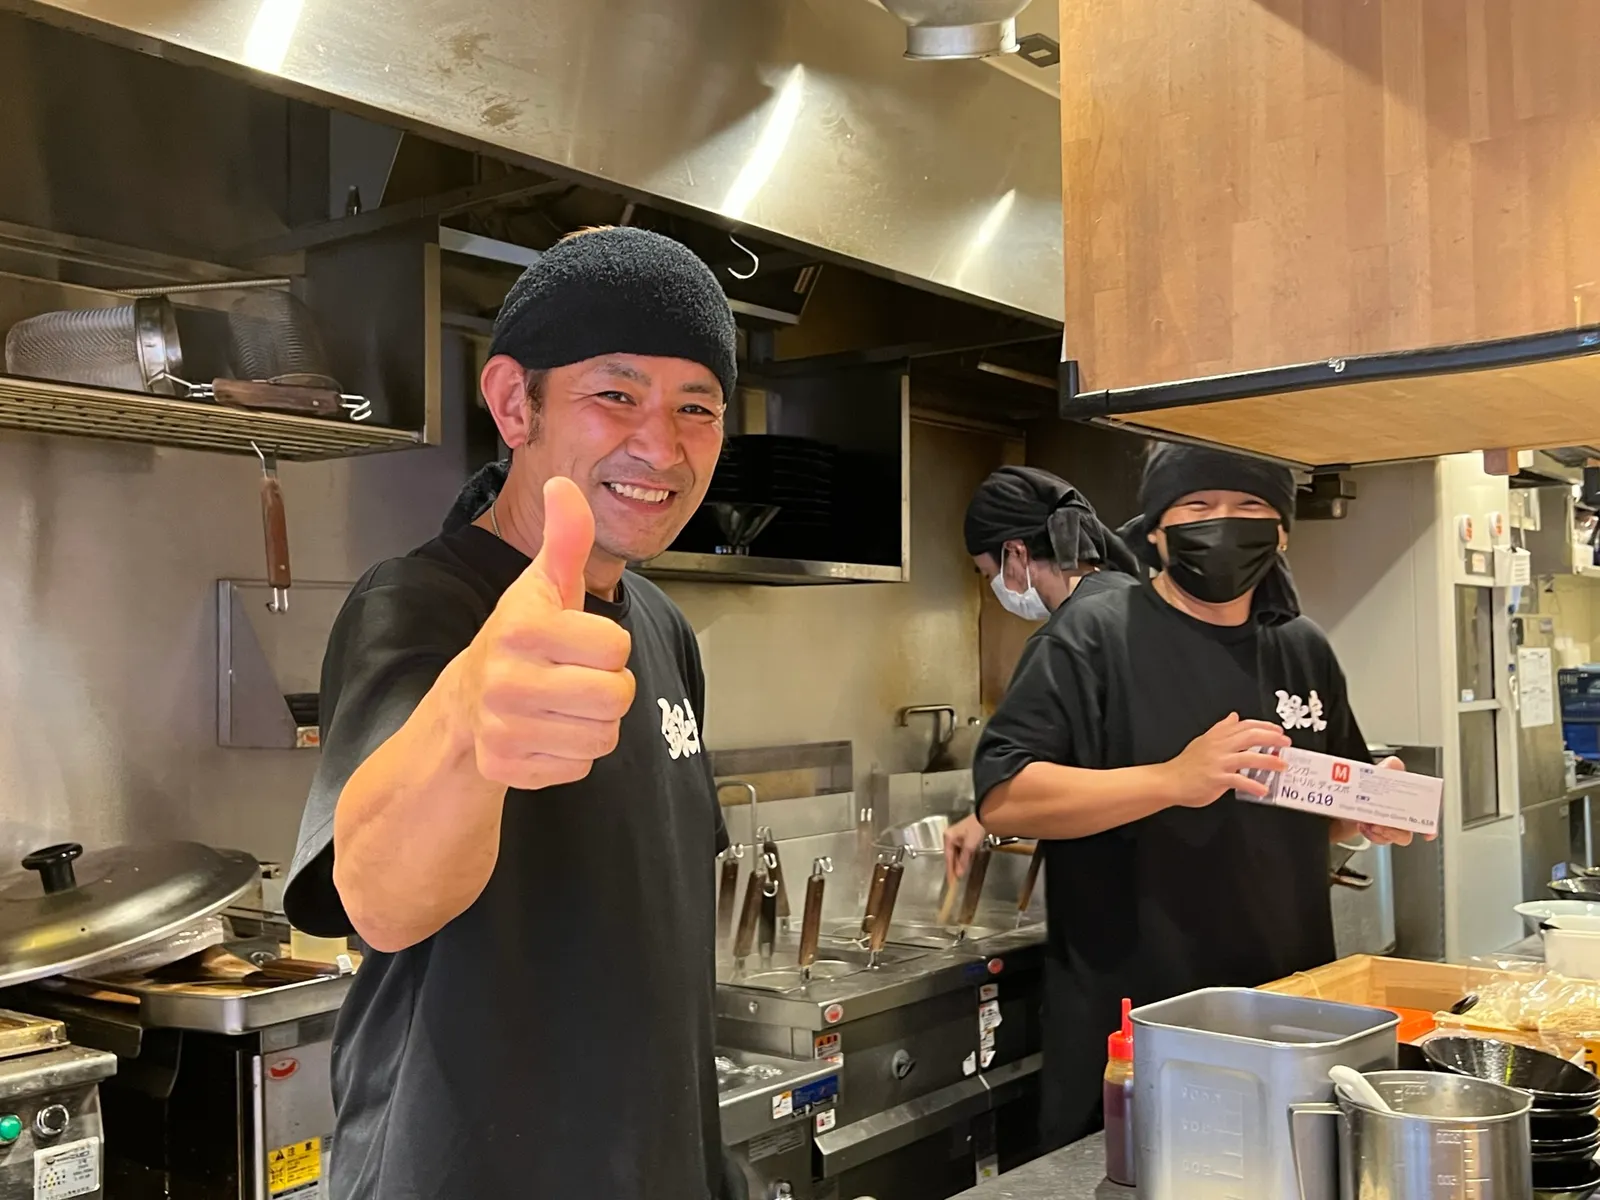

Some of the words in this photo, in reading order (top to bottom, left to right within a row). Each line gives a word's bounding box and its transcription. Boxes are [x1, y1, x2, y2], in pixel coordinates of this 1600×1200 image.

[1334, 764, 1348, 782] M
[1280, 786, 1334, 807] No.610
[1408, 816, 1435, 827] No.610
